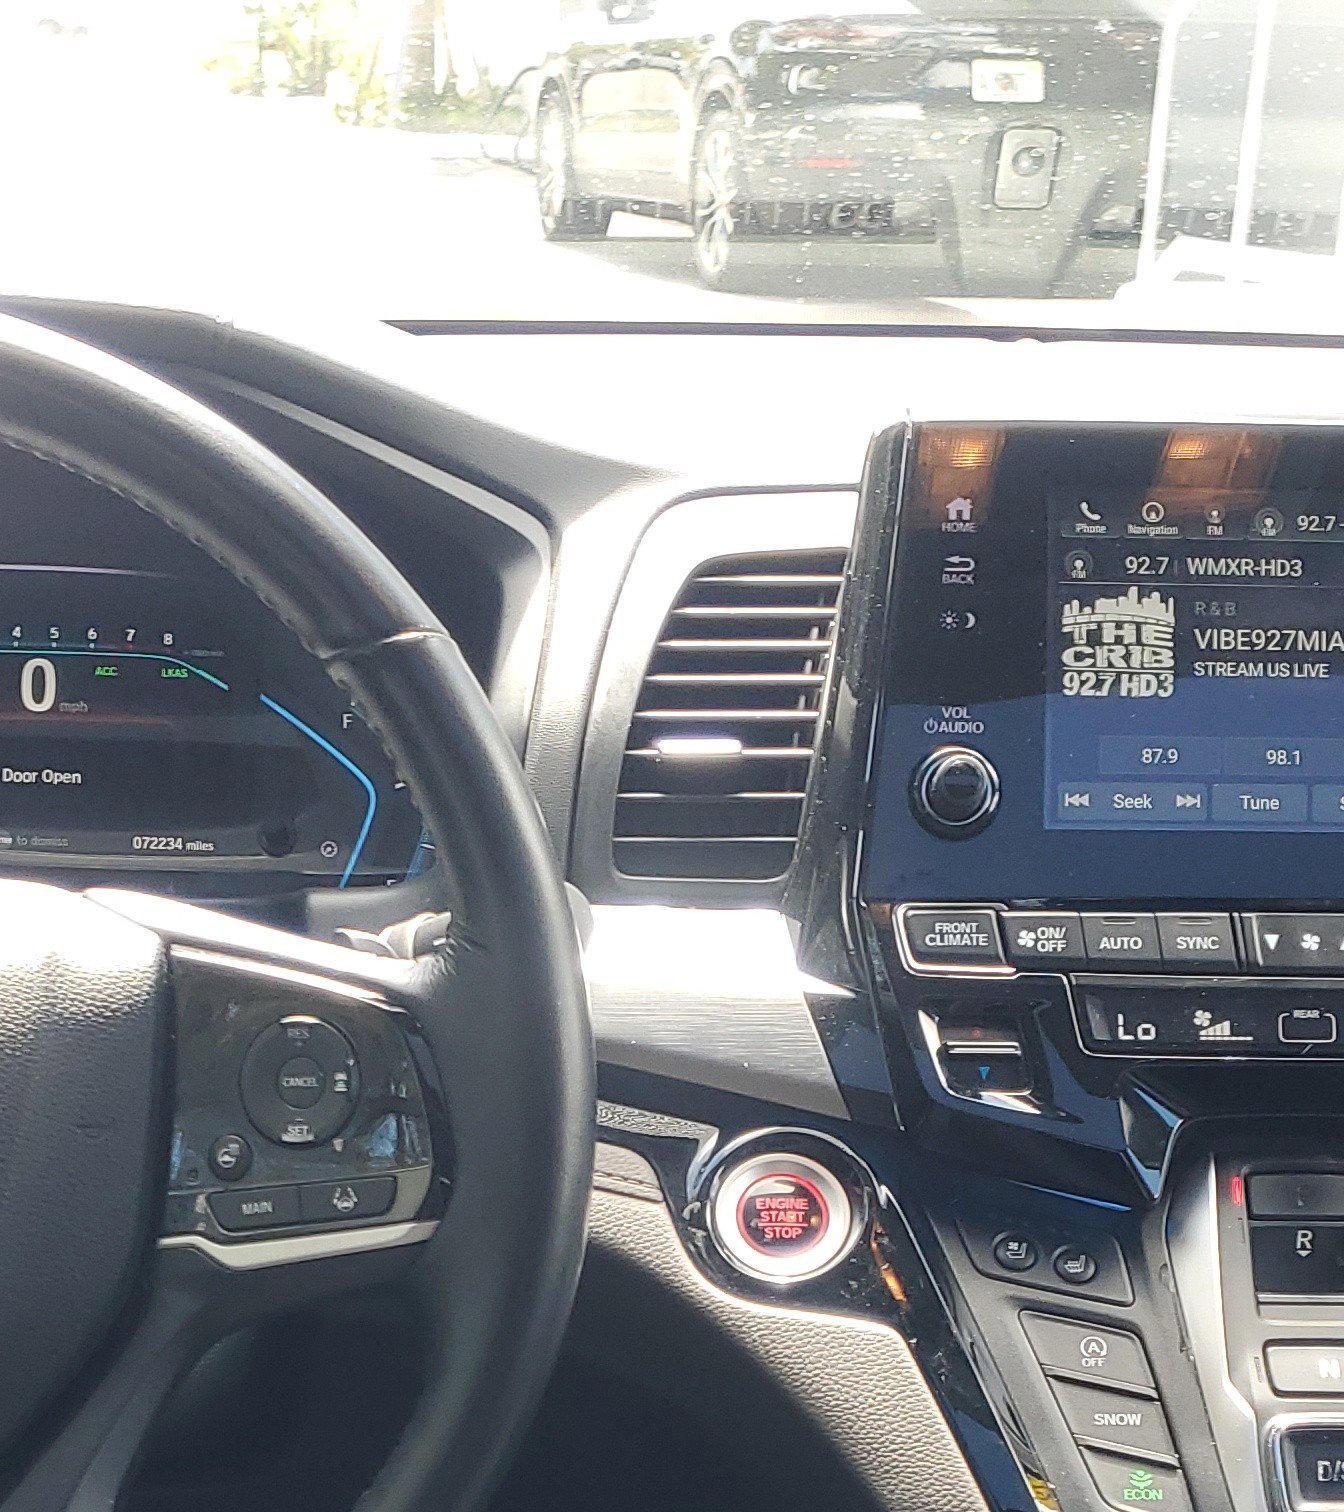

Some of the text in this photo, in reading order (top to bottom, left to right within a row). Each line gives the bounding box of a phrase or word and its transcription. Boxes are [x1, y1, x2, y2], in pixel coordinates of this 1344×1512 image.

[942, 523, 977, 533] HOME
[1076, 524, 1107, 534] Phone
[1128, 524, 1178, 536] Navigation
[1297, 516, 1334, 532] 92.7
[1125, 556, 1303, 577] 92.7 WMXR-HD3
[942, 573, 975, 584] BACK
[12, 625, 22, 638] 4
[49, 627, 60, 639] 5
[87, 627, 98, 640] 6
[124, 628, 136, 641] 7
[163, 632, 174, 646] 8
[1061, 623, 1175, 648] THE
[1061, 645, 1175, 669] CRIB
[1193, 661, 1331, 679] STREAM US LIVE
[19, 657, 58, 712] 0
[1119, 673, 1175, 698] HD3
[941, 707, 971, 719] VOL
[342, 713, 354, 729] F
[938, 721, 984, 734] AUDIO
[1141, 748, 1179, 765] 87.9
[1266, 750, 1302, 766] 98.1
[1, 768, 82, 787] Door Open
[1113, 794, 1153, 810] Seek
[1240, 795, 1280, 810] Tune
[132, 835, 184, 851] 072234
[934, 922, 980, 934] FRONT
[1037, 927, 1067, 940] ON/
[924, 933, 990, 947] CLIMATE
[1037, 939, 1067, 952] OFF
[1099, 936, 1143, 951] AUTO
[1176, 936, 1220, 951] SYNC
[755, 1198, 809, 1211] ENGINE
[759, 1211, 805, 1223] START
[764, 1226, 803, 1239] STOP
[1296, 1229, 1314, 1250] R
[1082, 1357, 1105, 1367] OFF
[1317, 1357, 1340, 1380] N
[1094, 1413, 1142, 1427] SNOW
[1123, 1487, 1163, 1500] ECON
